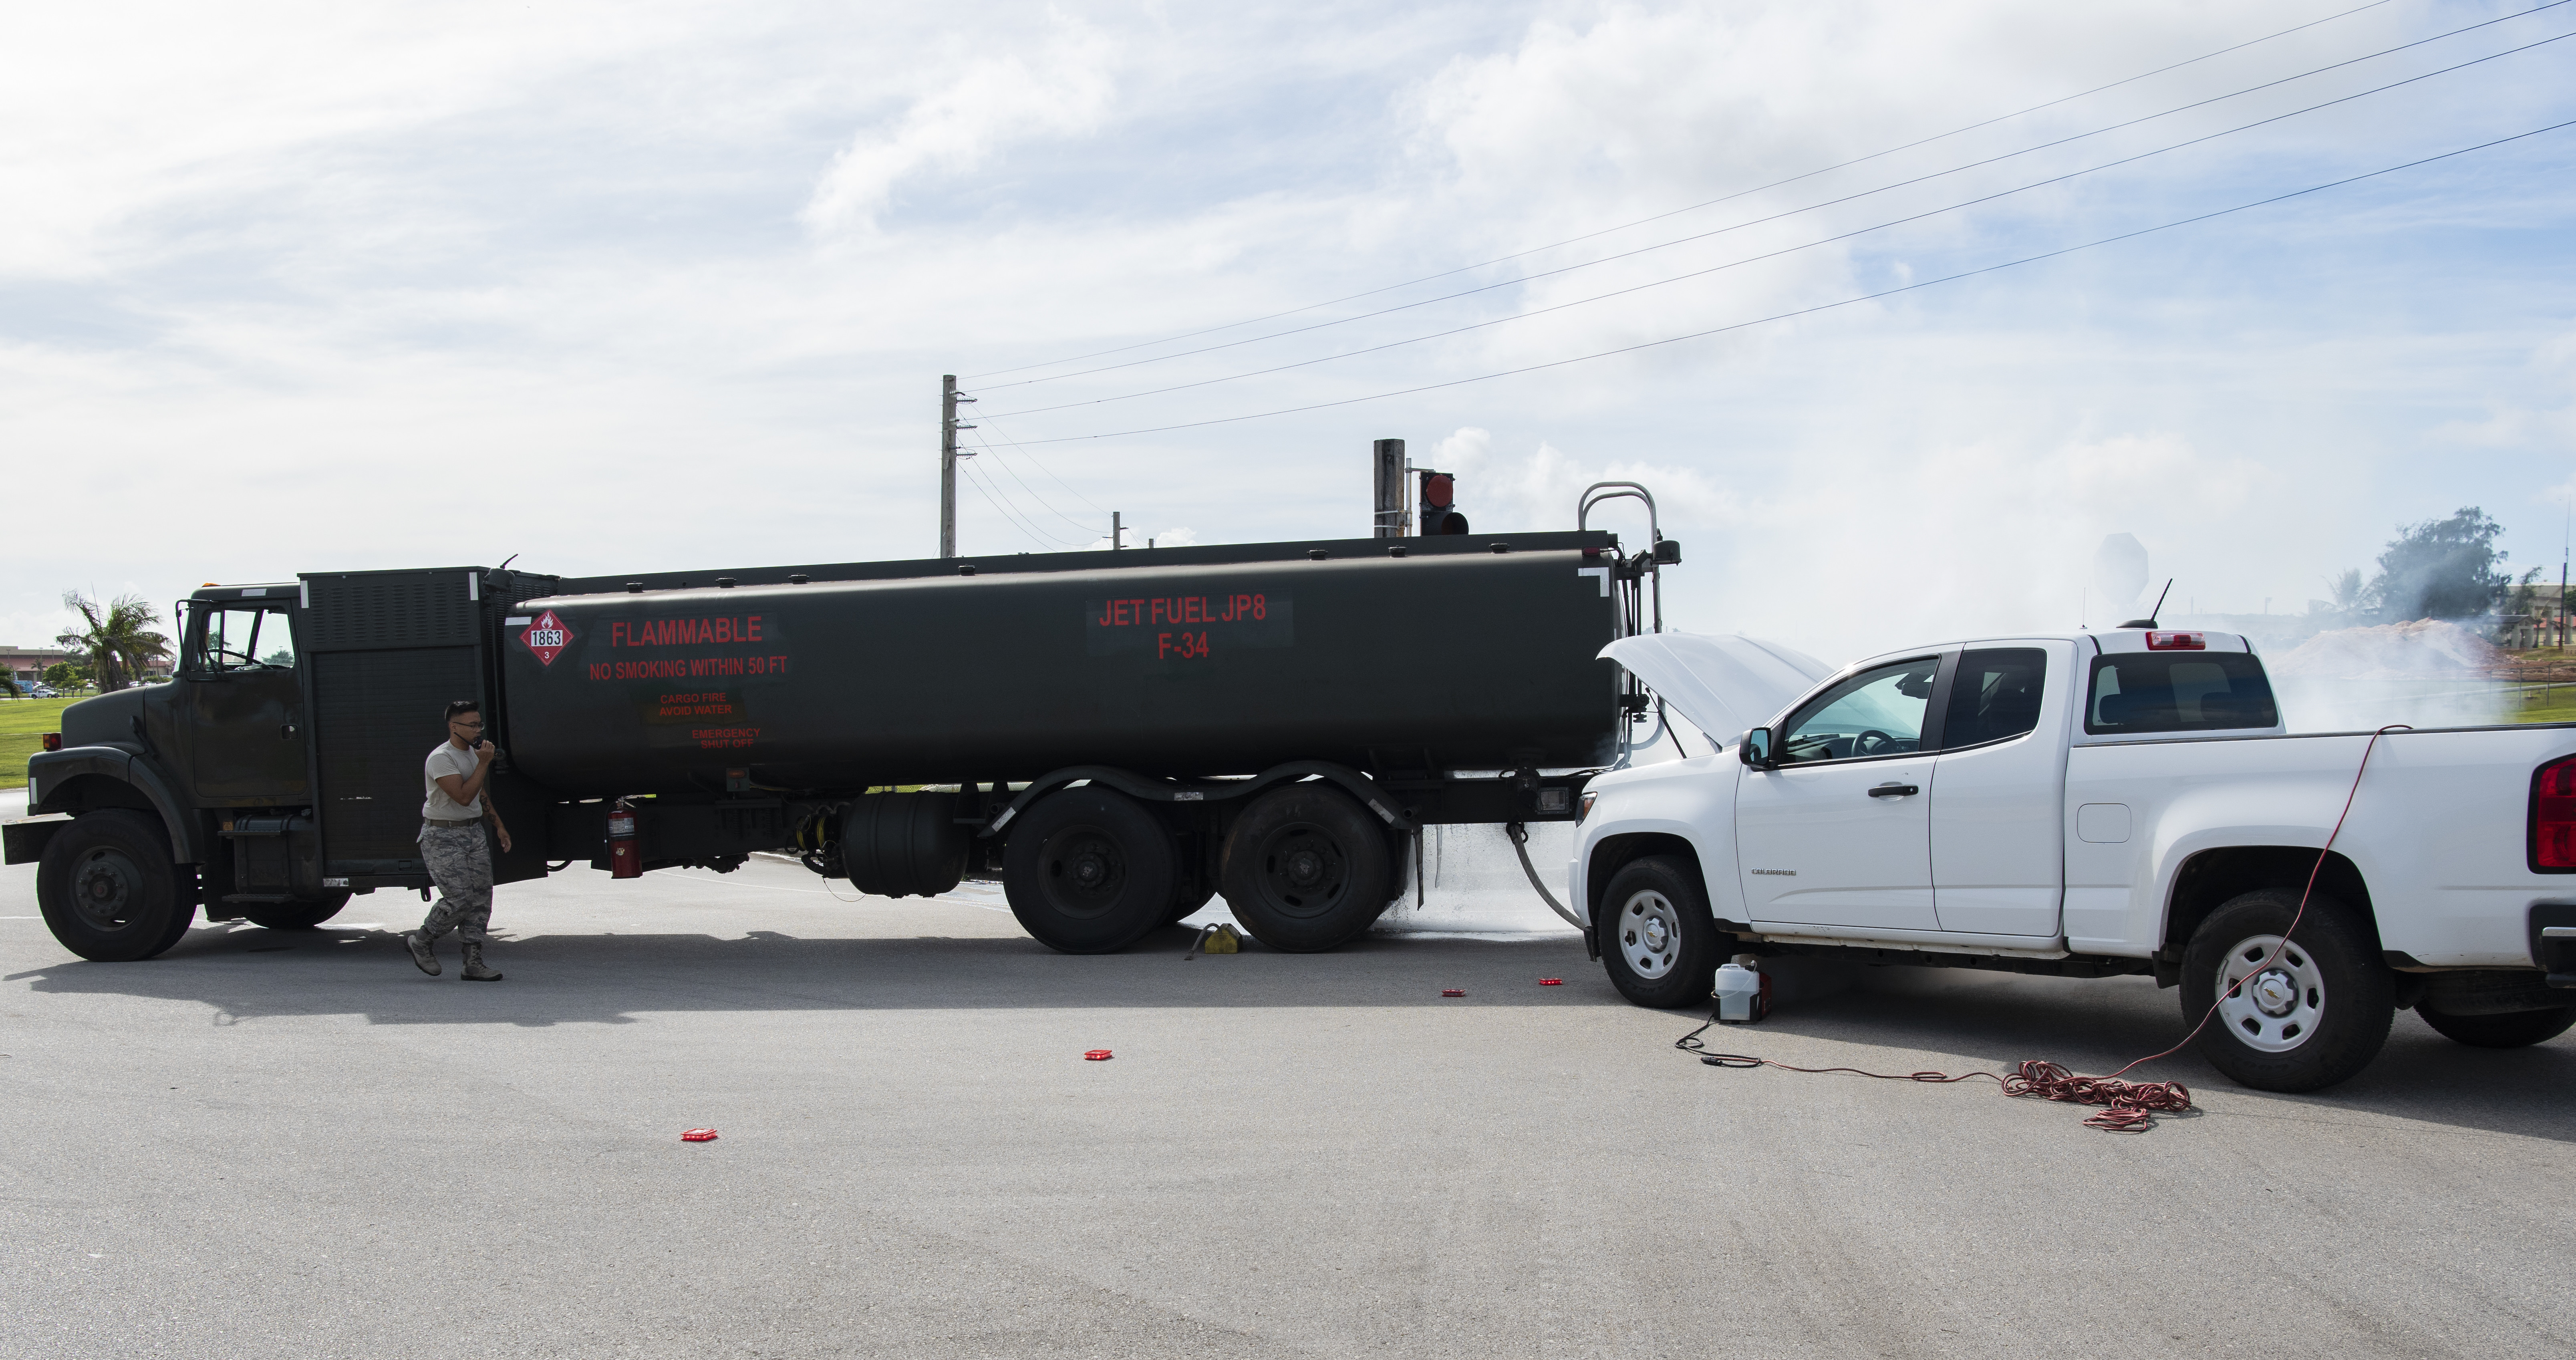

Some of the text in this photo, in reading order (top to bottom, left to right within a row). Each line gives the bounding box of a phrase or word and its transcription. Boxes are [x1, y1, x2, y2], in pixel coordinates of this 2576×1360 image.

[1099, 594, 1266, 626] JET FUEL JP8
[532, 631, 561, 645] 1863
[612, 616, 762, 647] FLAMMABLE
[1158, 631, 1209, 659] F-34
[590, 656, 787, 680] NO SMOKING WITHIN 50 FT
[660, 692, 727, 704] CARGO FIRE
[659, 704, 732, 716] AVOID WATER
[692, 728, 760, 739] EMERGENCY
[701, 738, 754, 749] SHUT OFF
